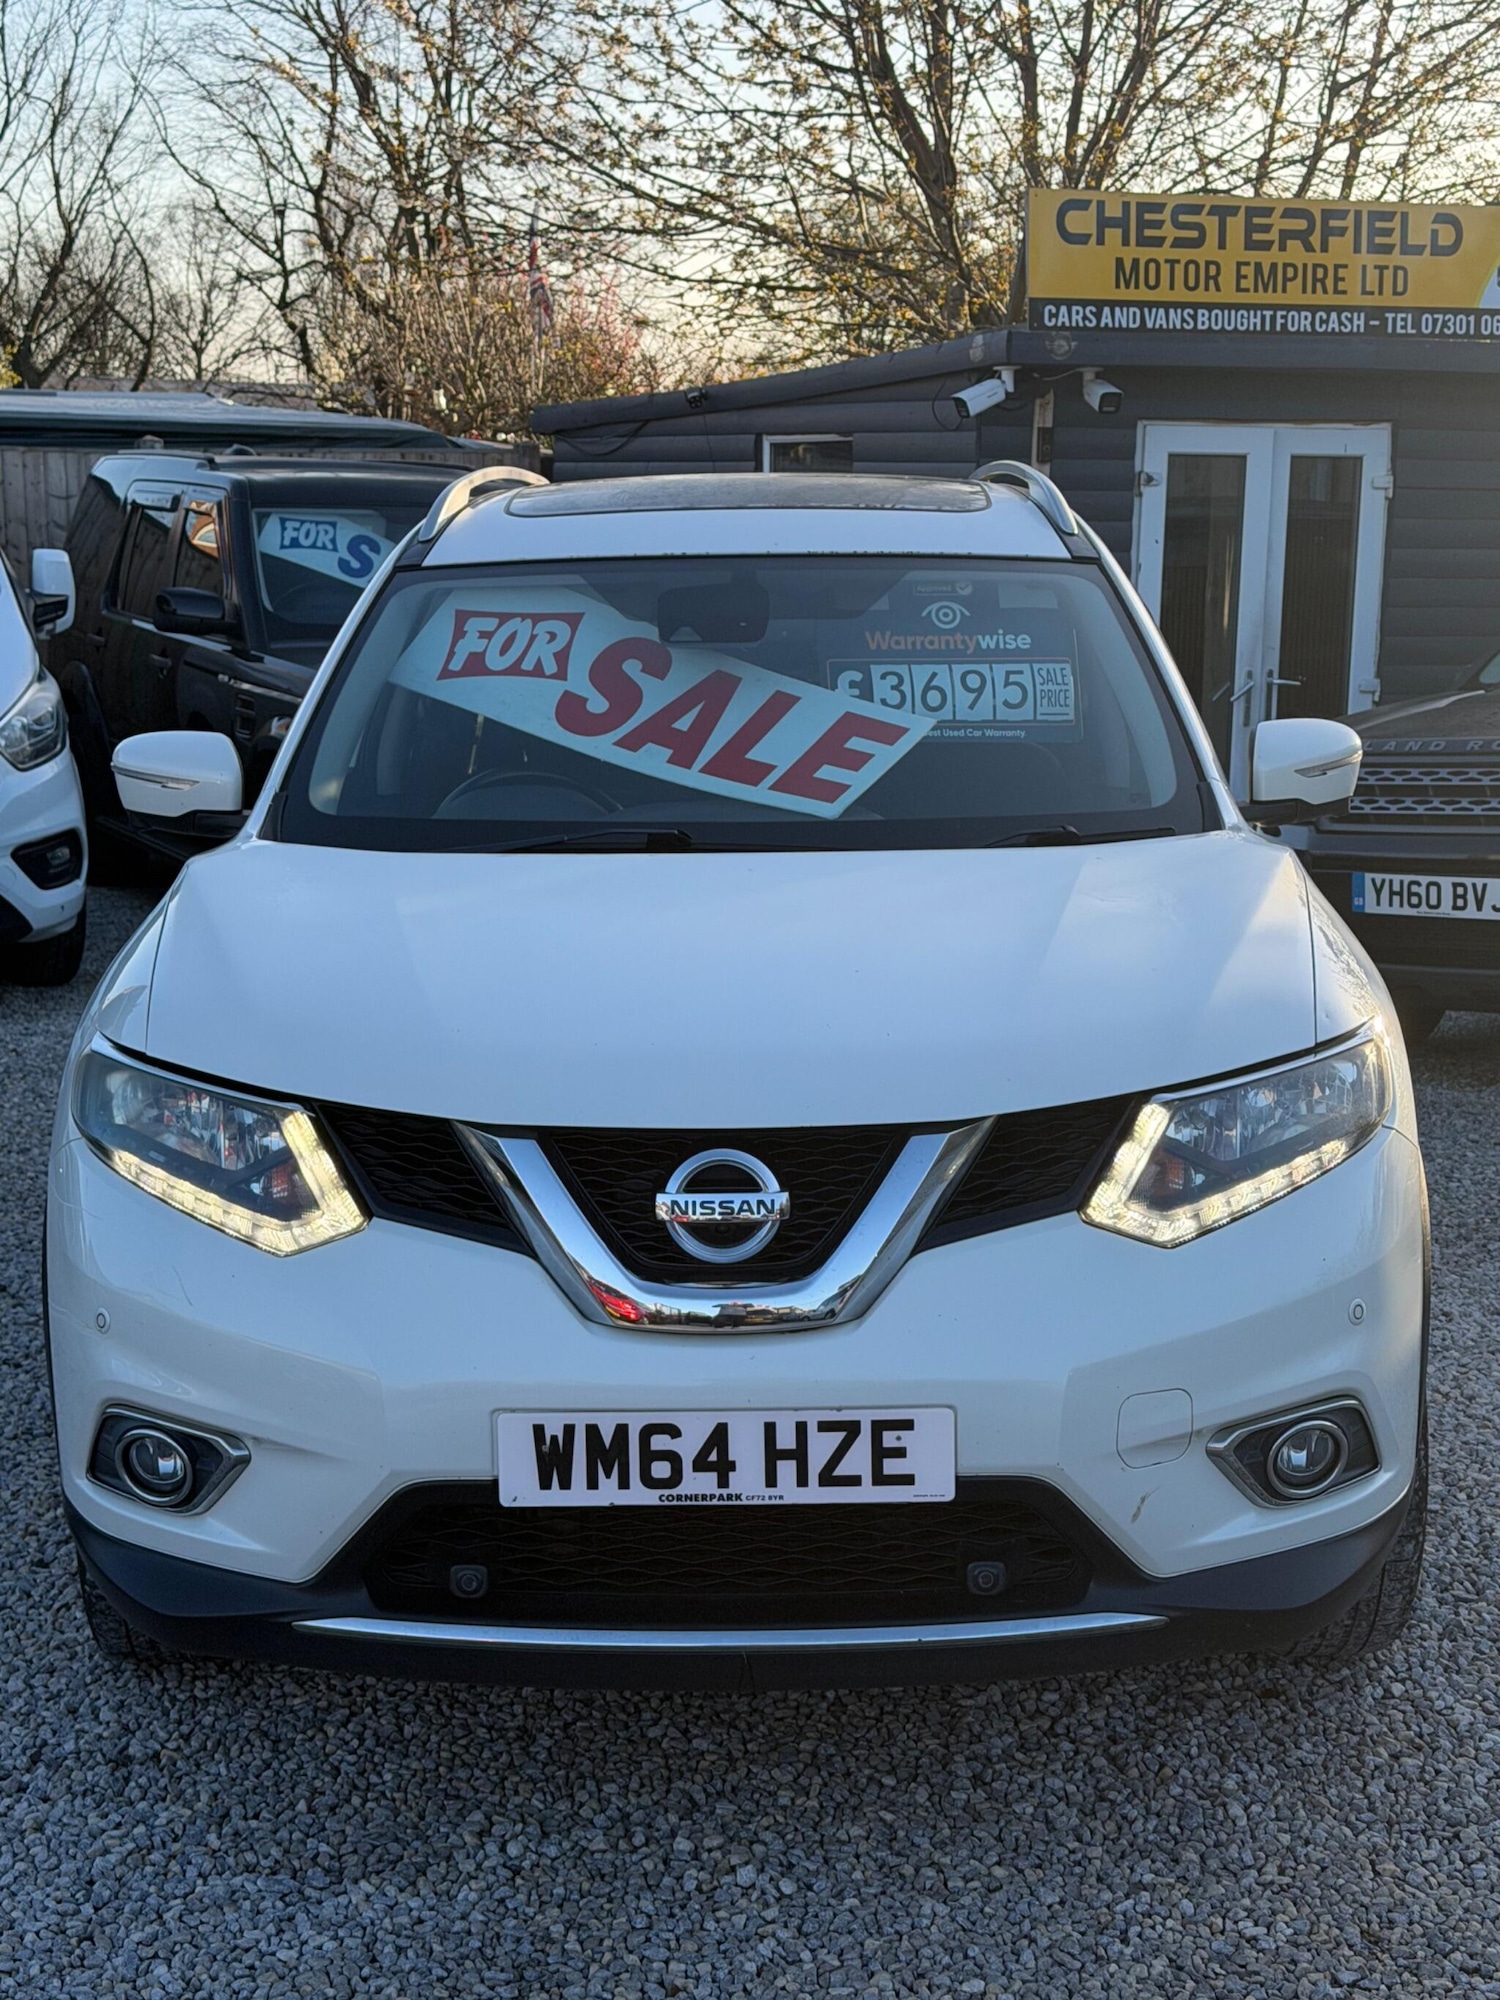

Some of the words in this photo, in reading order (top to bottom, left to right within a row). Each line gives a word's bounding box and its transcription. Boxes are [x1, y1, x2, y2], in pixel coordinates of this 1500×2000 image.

[1056, 198, 1464, 257] CHESTERFIELD
[1115, 257, 1222, 293] MOTOR
[1235, 261, 1348, 295] EMPIRE
[1360, 264, 1409, 296] LTD
[1043, 304, 1097, 328] CARS
[1100, 306, 1141, 329] AND
[1144, 307, 1195, 331] VANS
[1197, 308, 1274, 332] BOUGHT
[1276, 310, 1312, 332] FOR
[1315, 311, 1365, 333] CASH
[1385, 312, 1417, 334] TEL
[1421, 313, 1475, 335] 07301
[283, 520, 335, 550] FOR
[865, 628, 1032, 654] Warrantywise
[1037, 667, 1069, 687] SALE
[446, 616, 571, 677] FOR
[555, 637, 911, 804] SALE
[1039, 688, 1070, 708] PRICE
[943, 728, 965, 737] Used
[966, 728, 982, 737] Car
[984, 728, 1025, 739] Warranty
[1363, 740, 1446, 751] LAND
[1371, 877, 1442, 910] YH60
[670, 1199, 775, 1216] NISSAN
[532, 1422, 737, 1491] WM64
[763, 1418, 916, 1488] HZE
[658, 1492, 744, 1503] CORNERPARK
